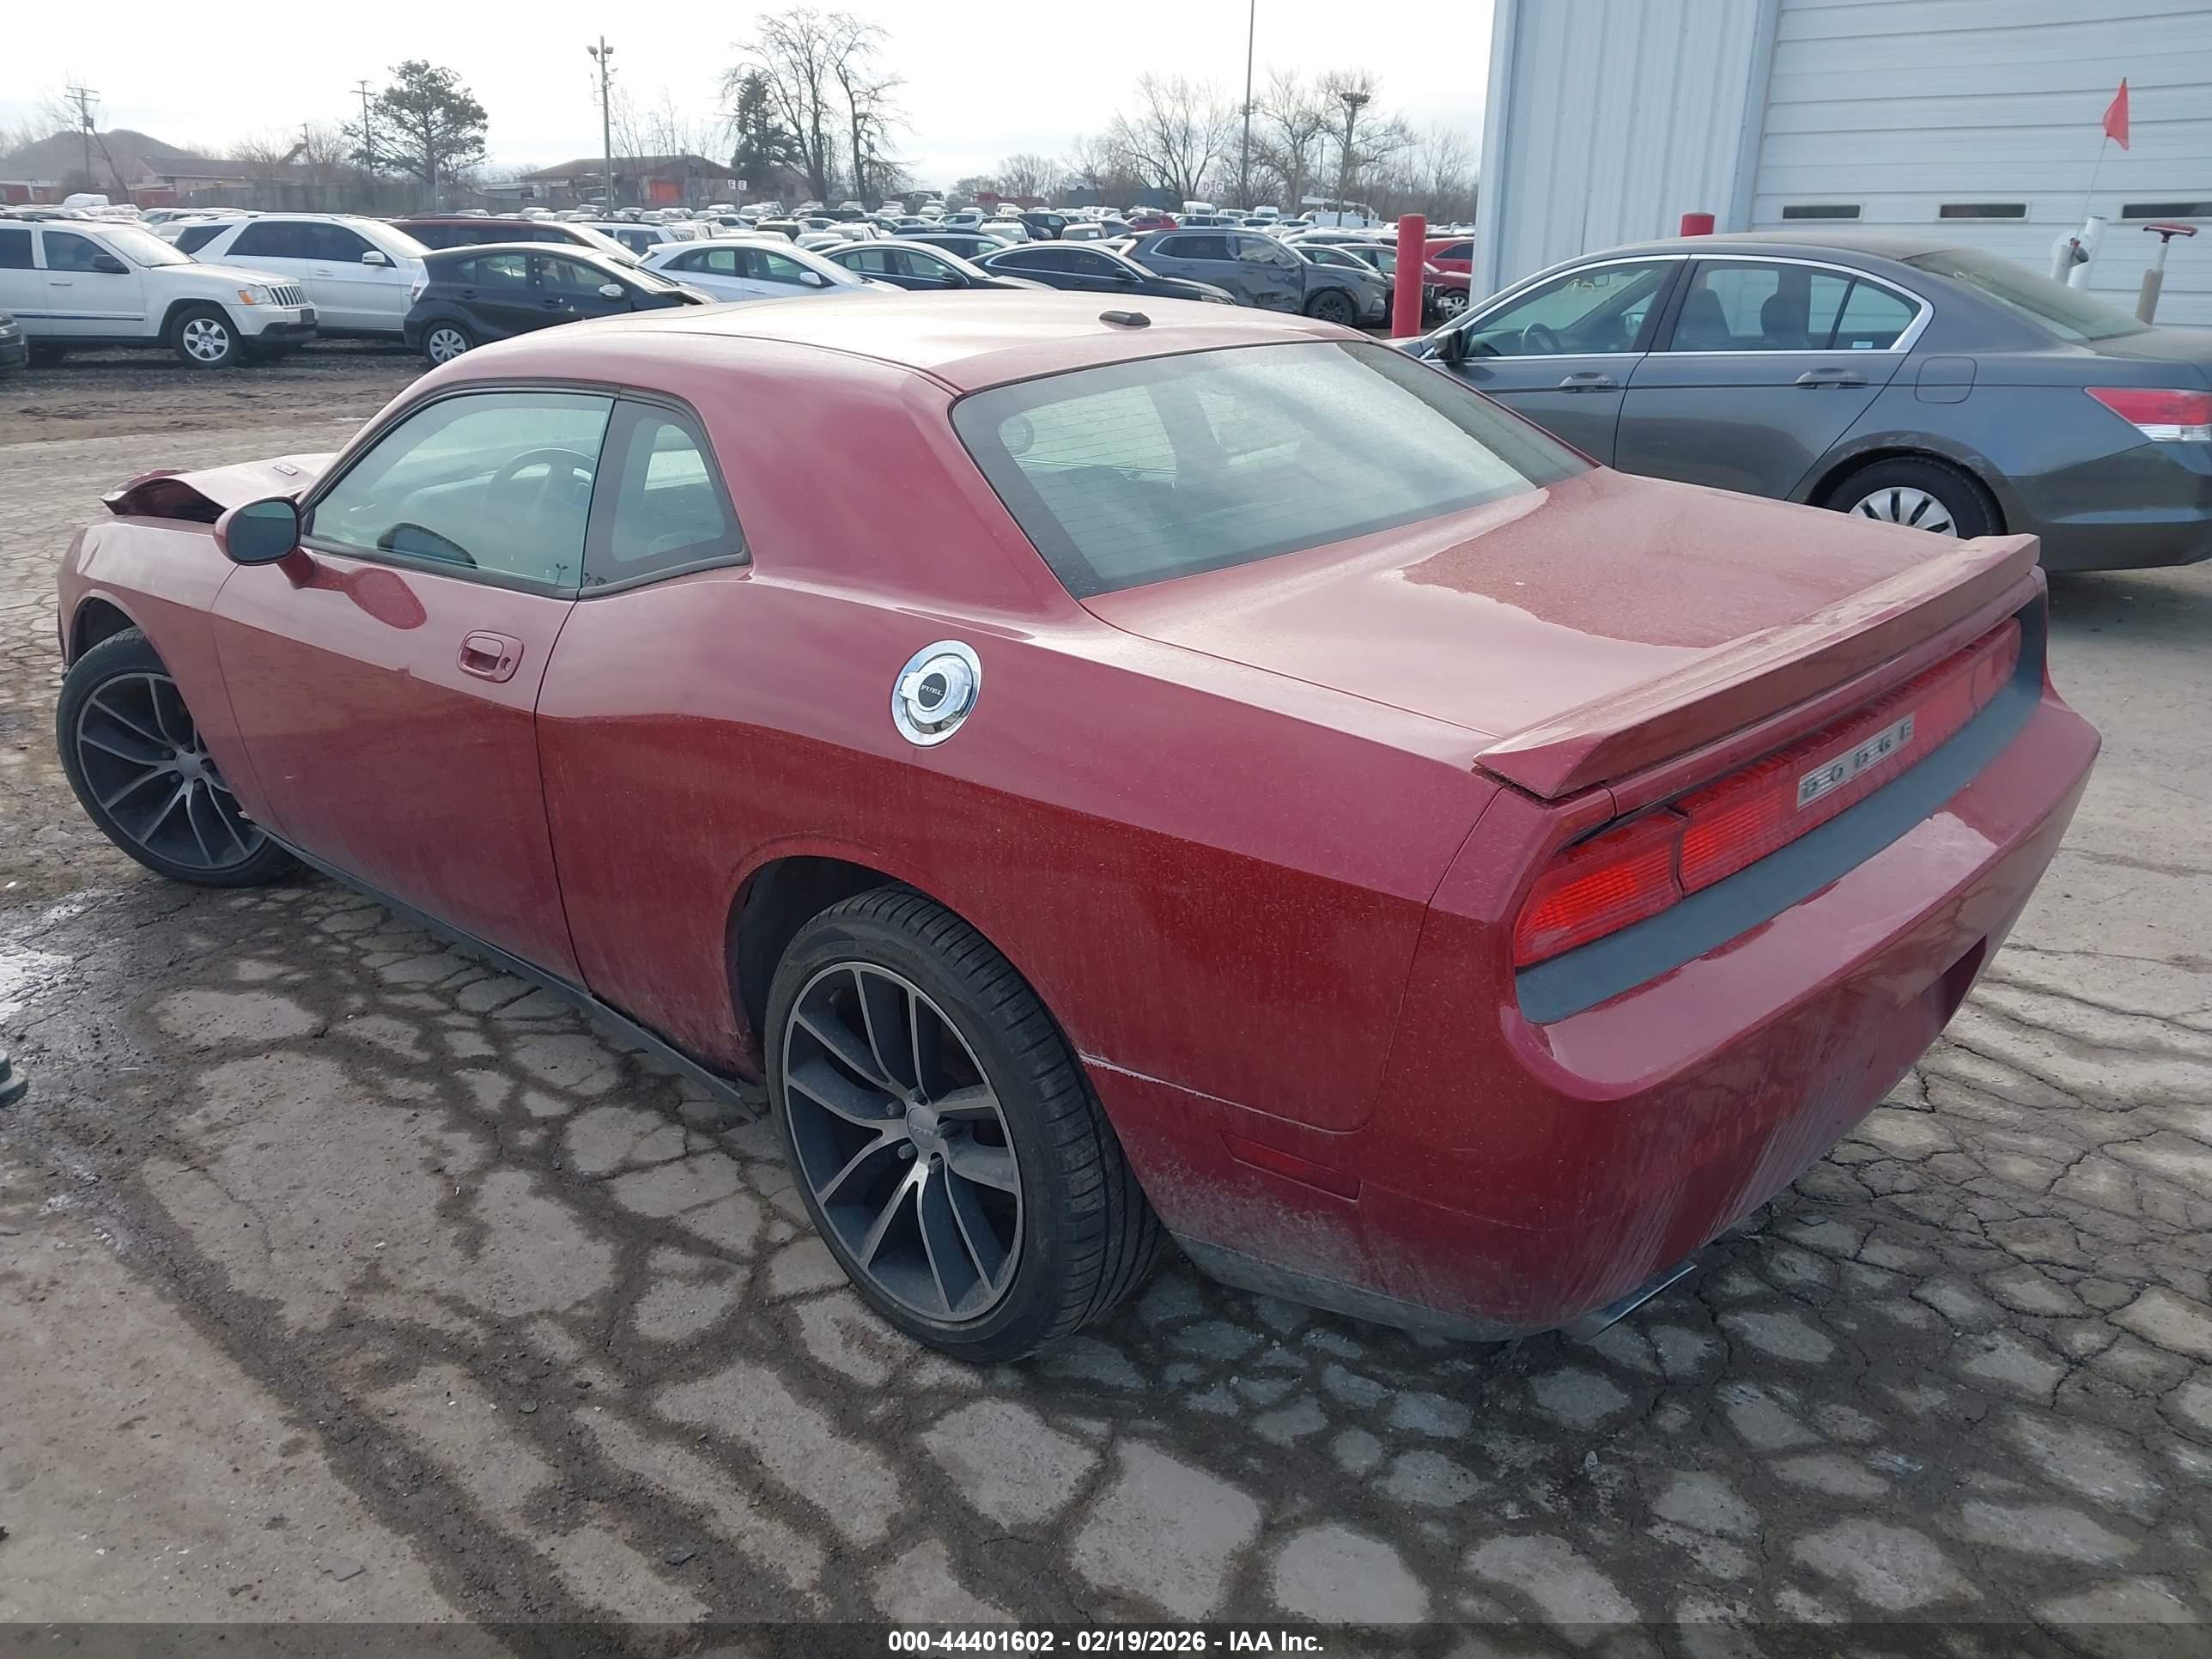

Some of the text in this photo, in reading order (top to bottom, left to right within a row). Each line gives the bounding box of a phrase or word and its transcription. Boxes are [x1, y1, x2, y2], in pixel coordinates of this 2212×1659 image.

[1203, 182, 1210, 191] D
[1216, 182, 1223, 191] C
[921, 684, 943, 696] FUEL
[1802, 720, 1912, 799] DODGE
